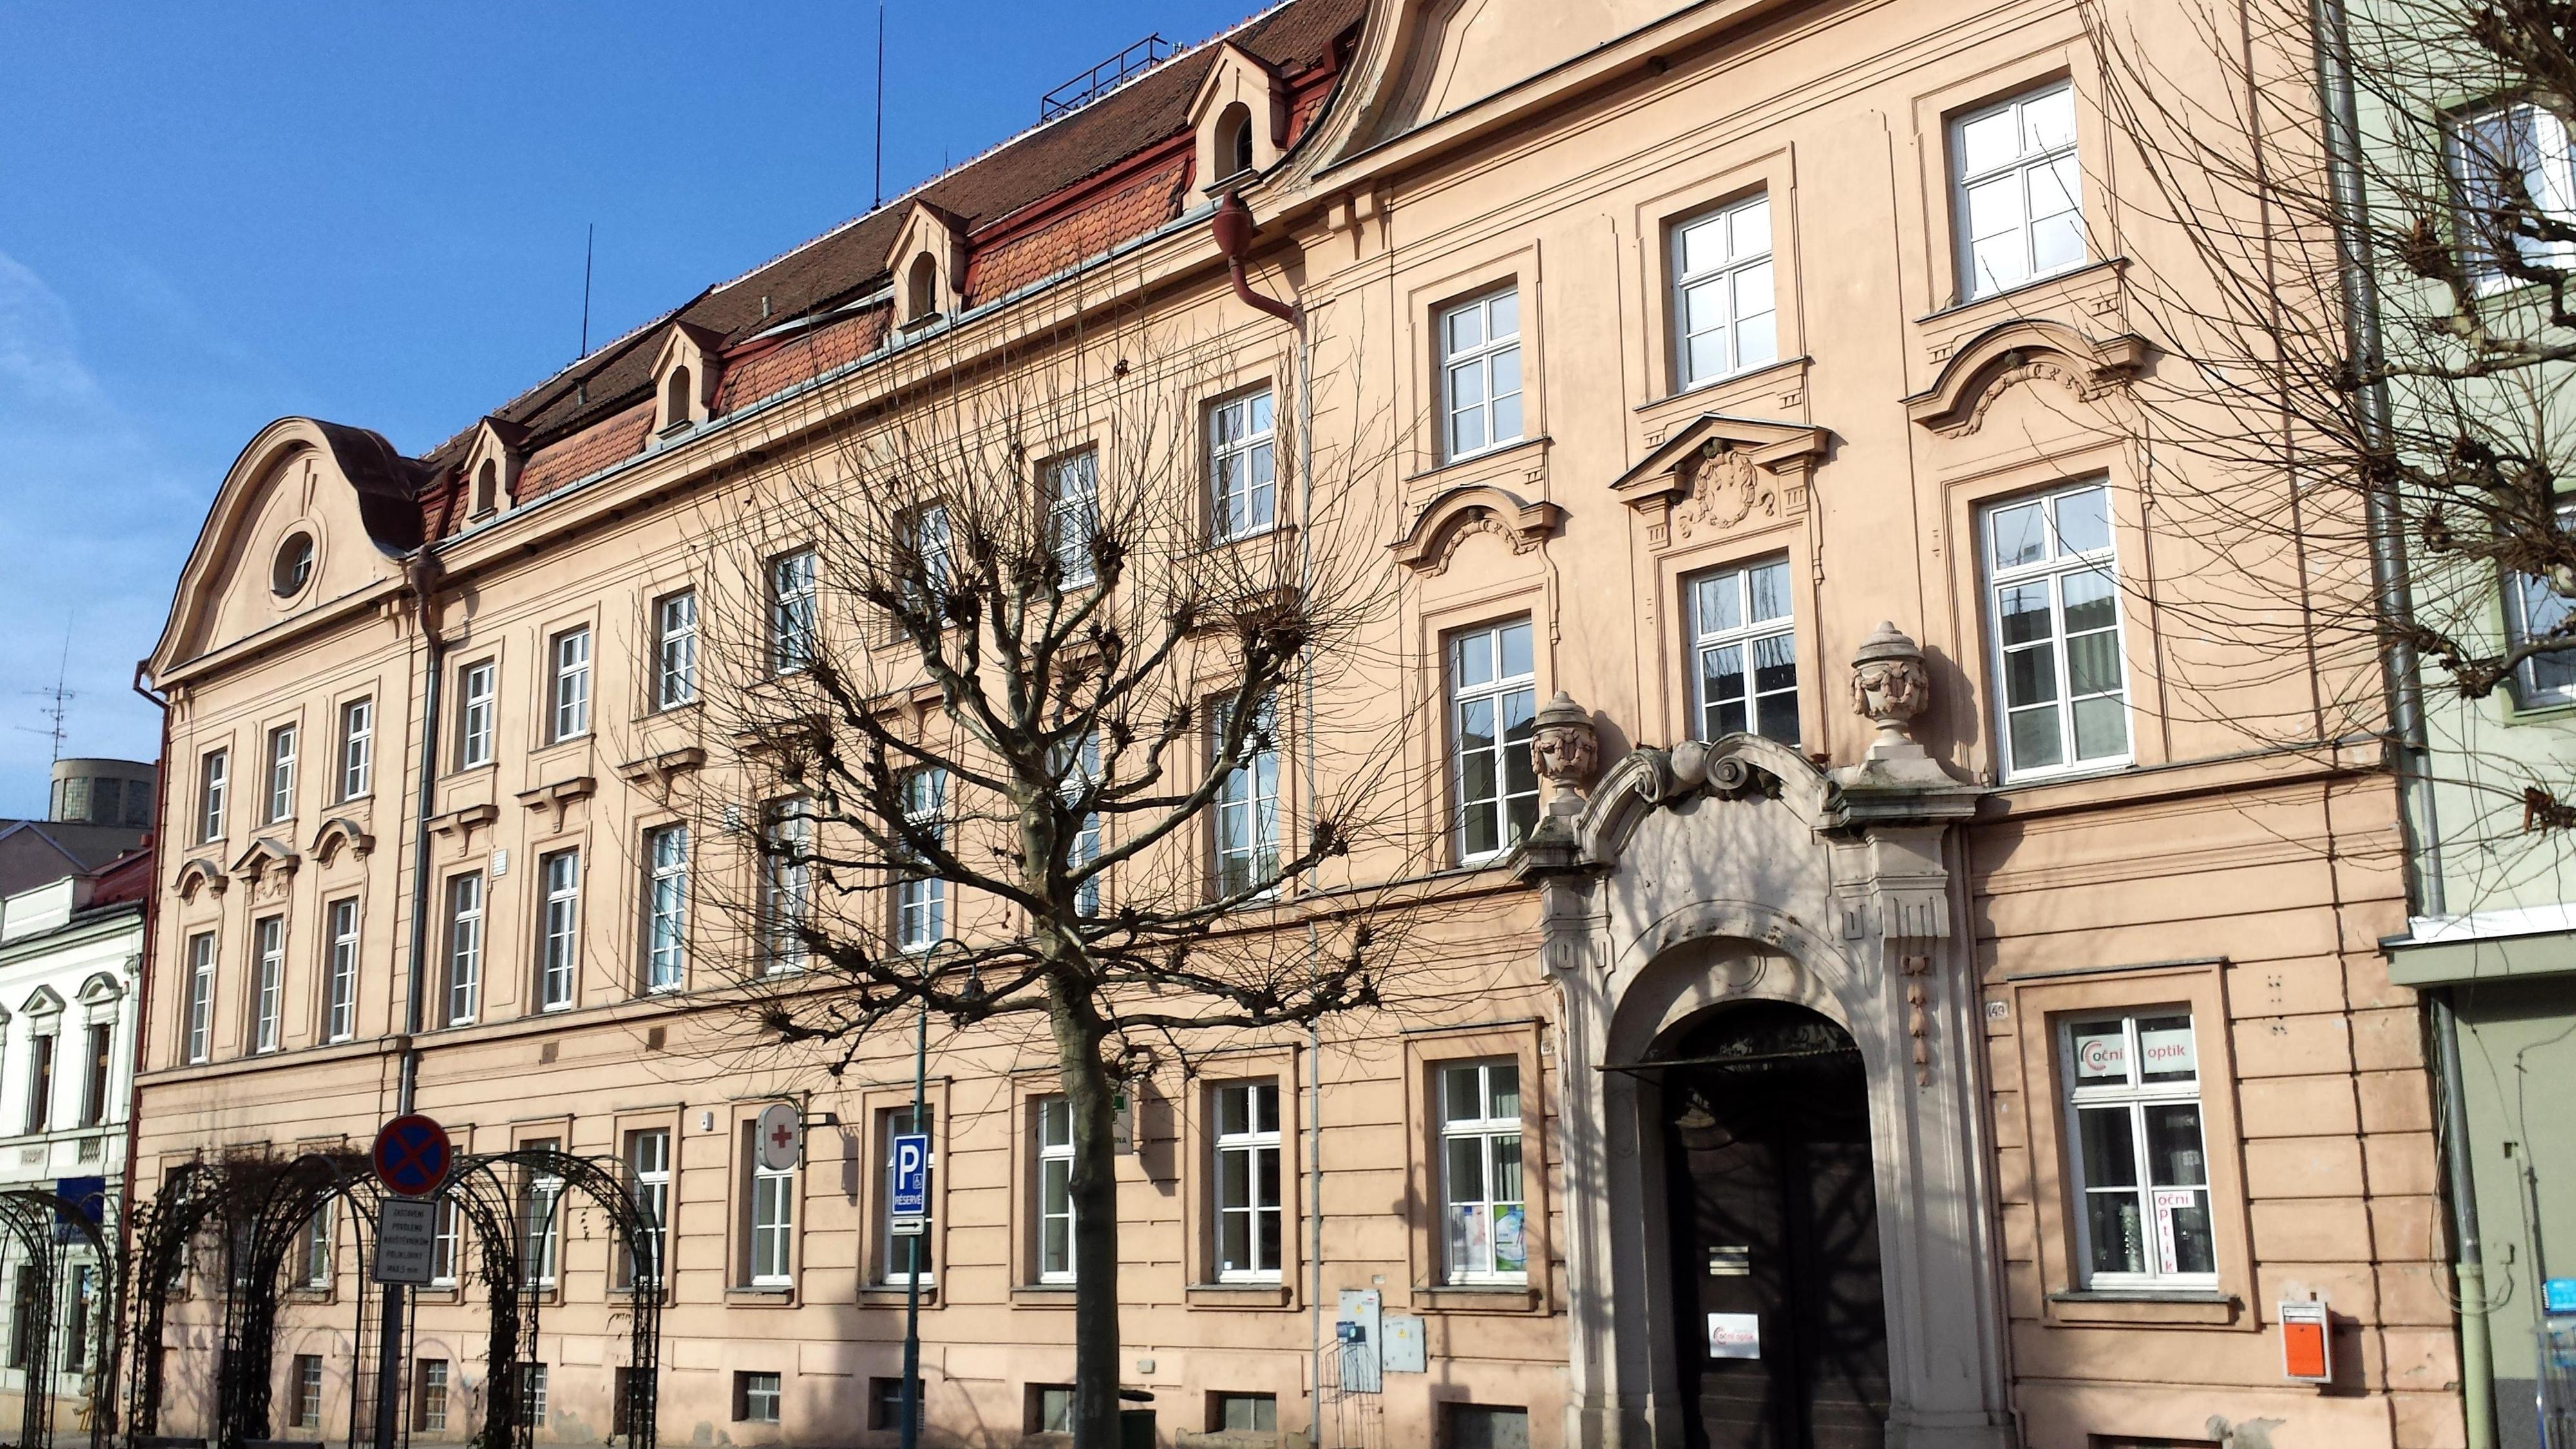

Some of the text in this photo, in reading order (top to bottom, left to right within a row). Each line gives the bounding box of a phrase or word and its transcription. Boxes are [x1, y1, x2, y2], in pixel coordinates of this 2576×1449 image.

[2093, 1044, 2185, 1061] oční optik
[899, 1144, 920, 1190] P
[2158, 1193, 2189, 1206] oční
